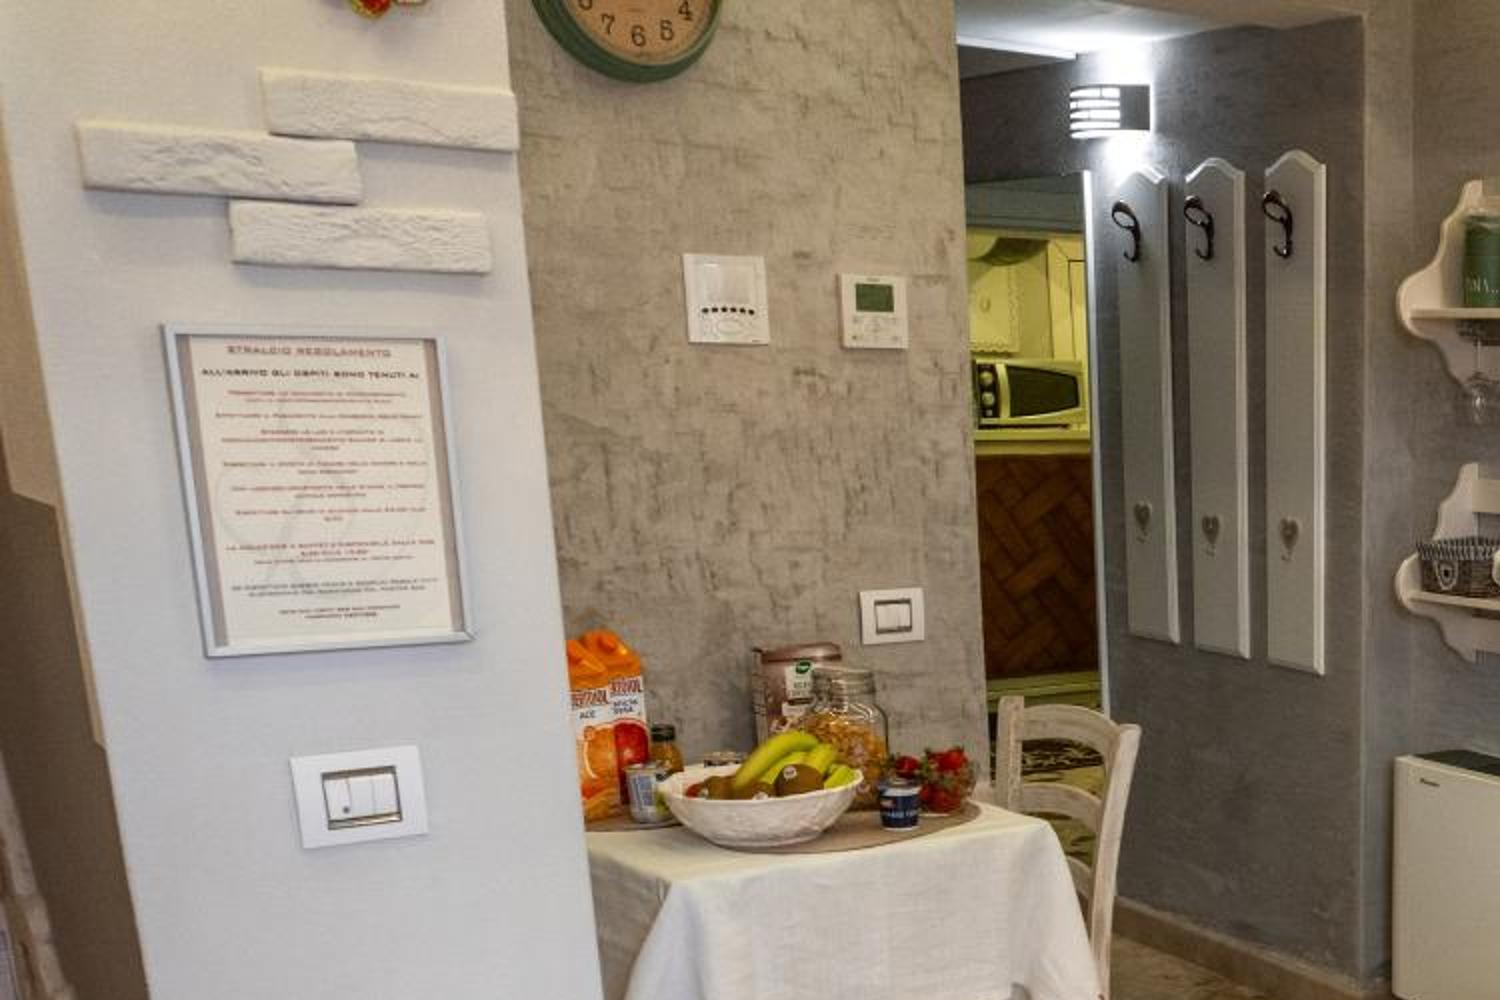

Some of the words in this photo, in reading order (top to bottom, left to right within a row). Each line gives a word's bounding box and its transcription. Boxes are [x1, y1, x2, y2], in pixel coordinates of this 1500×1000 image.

[678, 0, 694, 21] 4
[601, 13, 616, 36] 7
[660, 19, 675, 42] 5
[631, 25, 647, 48] 6
[296, 347, 392, 358] REGOLAMENTO
